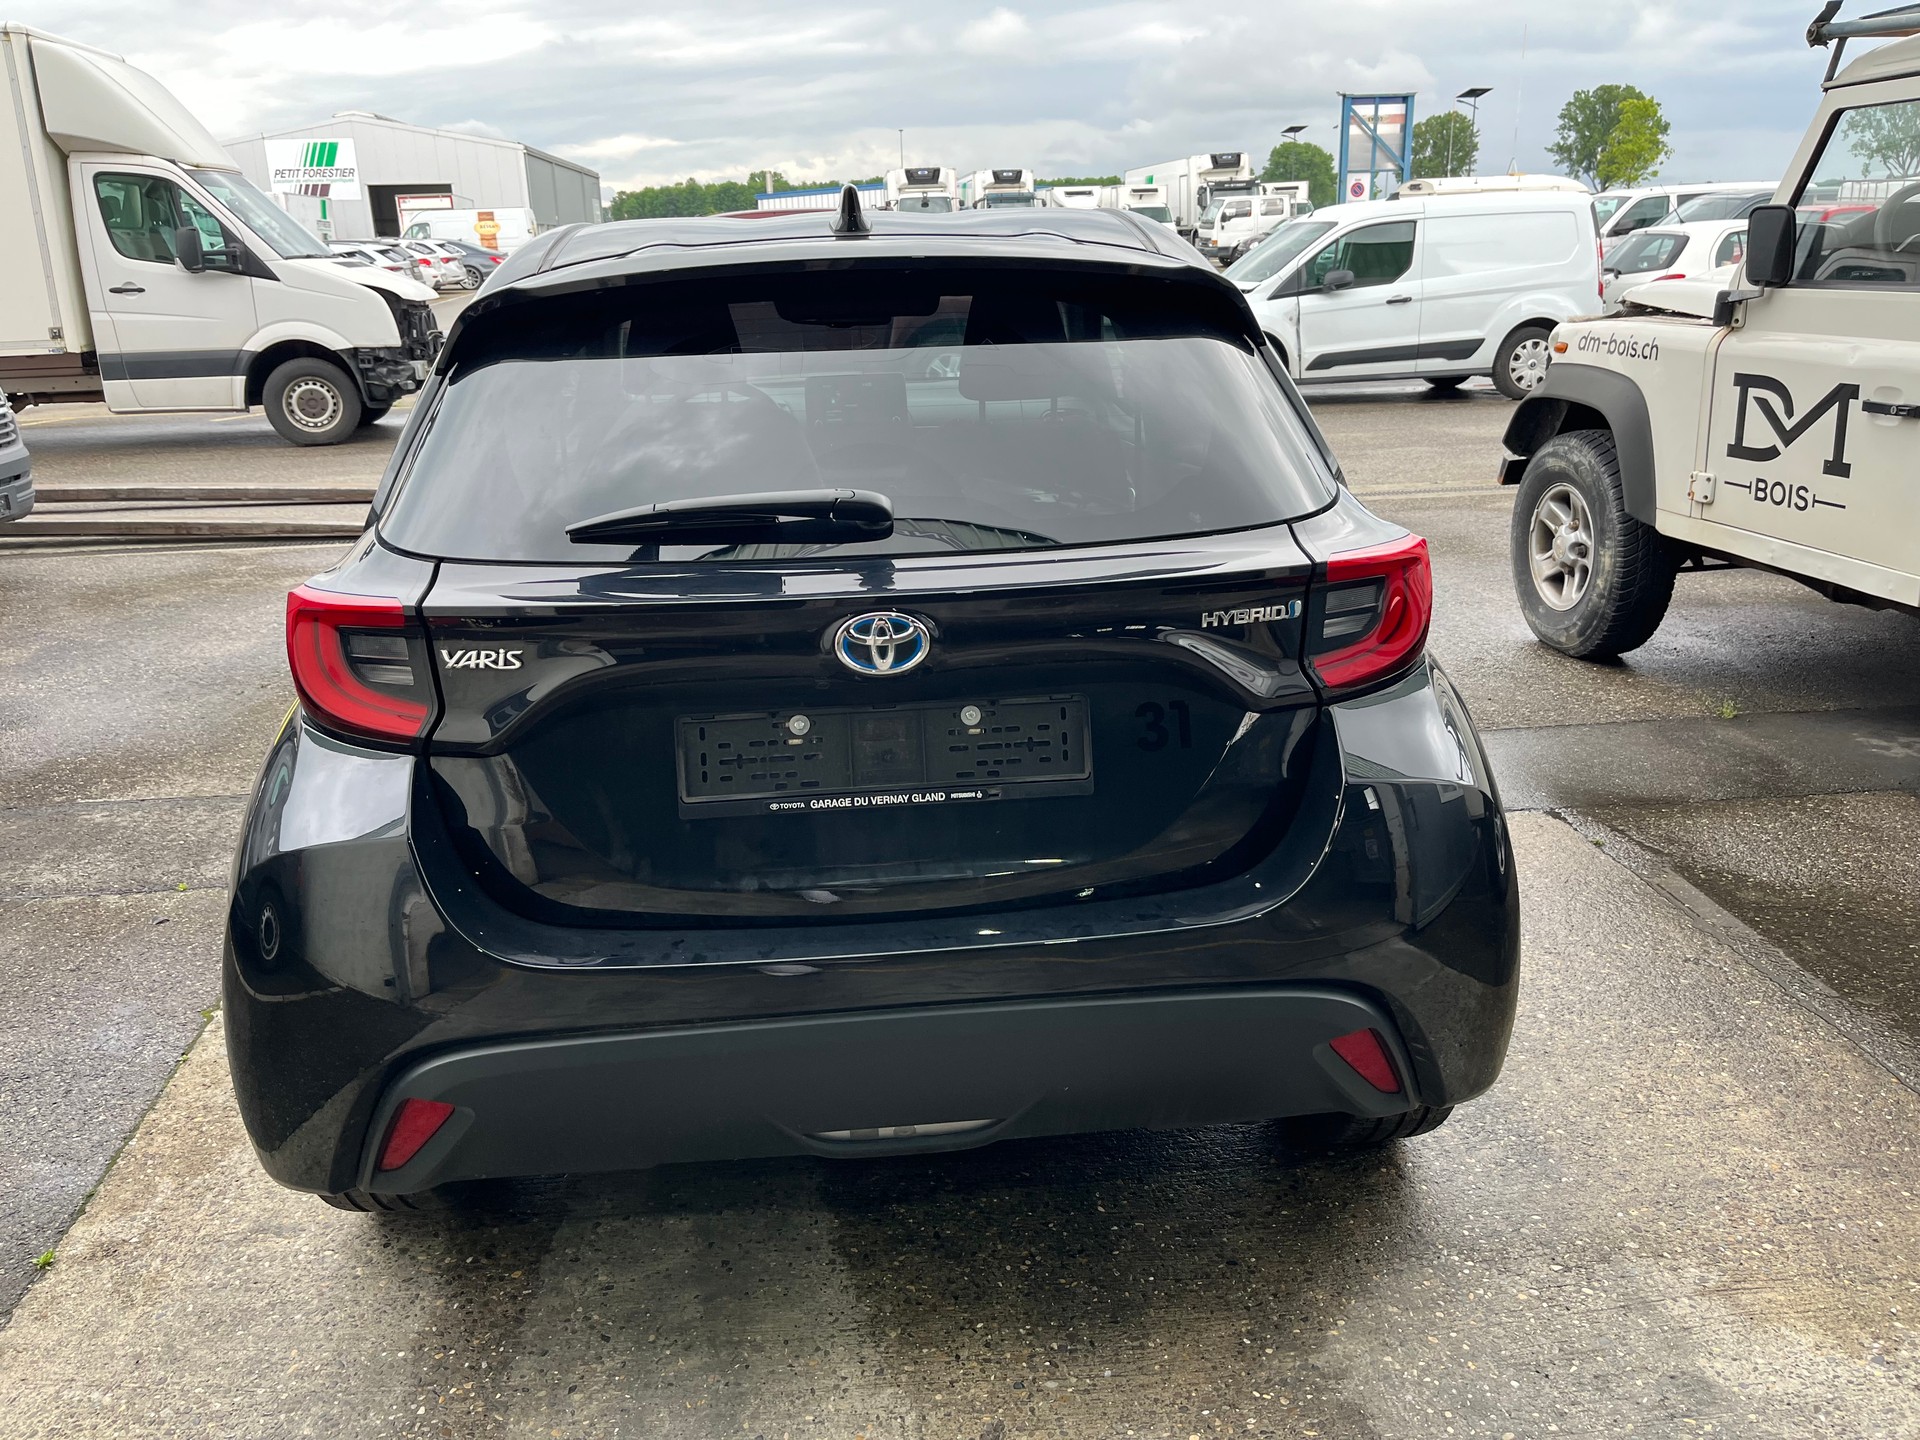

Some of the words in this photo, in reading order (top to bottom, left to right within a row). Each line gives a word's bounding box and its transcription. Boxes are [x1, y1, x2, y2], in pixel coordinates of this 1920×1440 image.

[274, 168, 301, 179] PETIT
[302, 167, 356, 178] FORESTIER
[1577, 330, 1660, 361] dm-bois.ch
[1726, 372, 1861, 479] DM
[1754, 477, 1810, 511] BOIS
[1201, 604, 1287, 628] HYBRID
[440, 648, 524, 670] YARIS
[1134, 700, 1193, 752] 31
[779, 802, 806, 810] TOYOTA
[810, 798, 852, 810] GARAGE
[853, 796, 869, 807] DU
[870, 794, 910, 806] VERNAY
[911, 791, 947, 804] GLAND
[950, 791, 976, 800] MITSUBISHI
